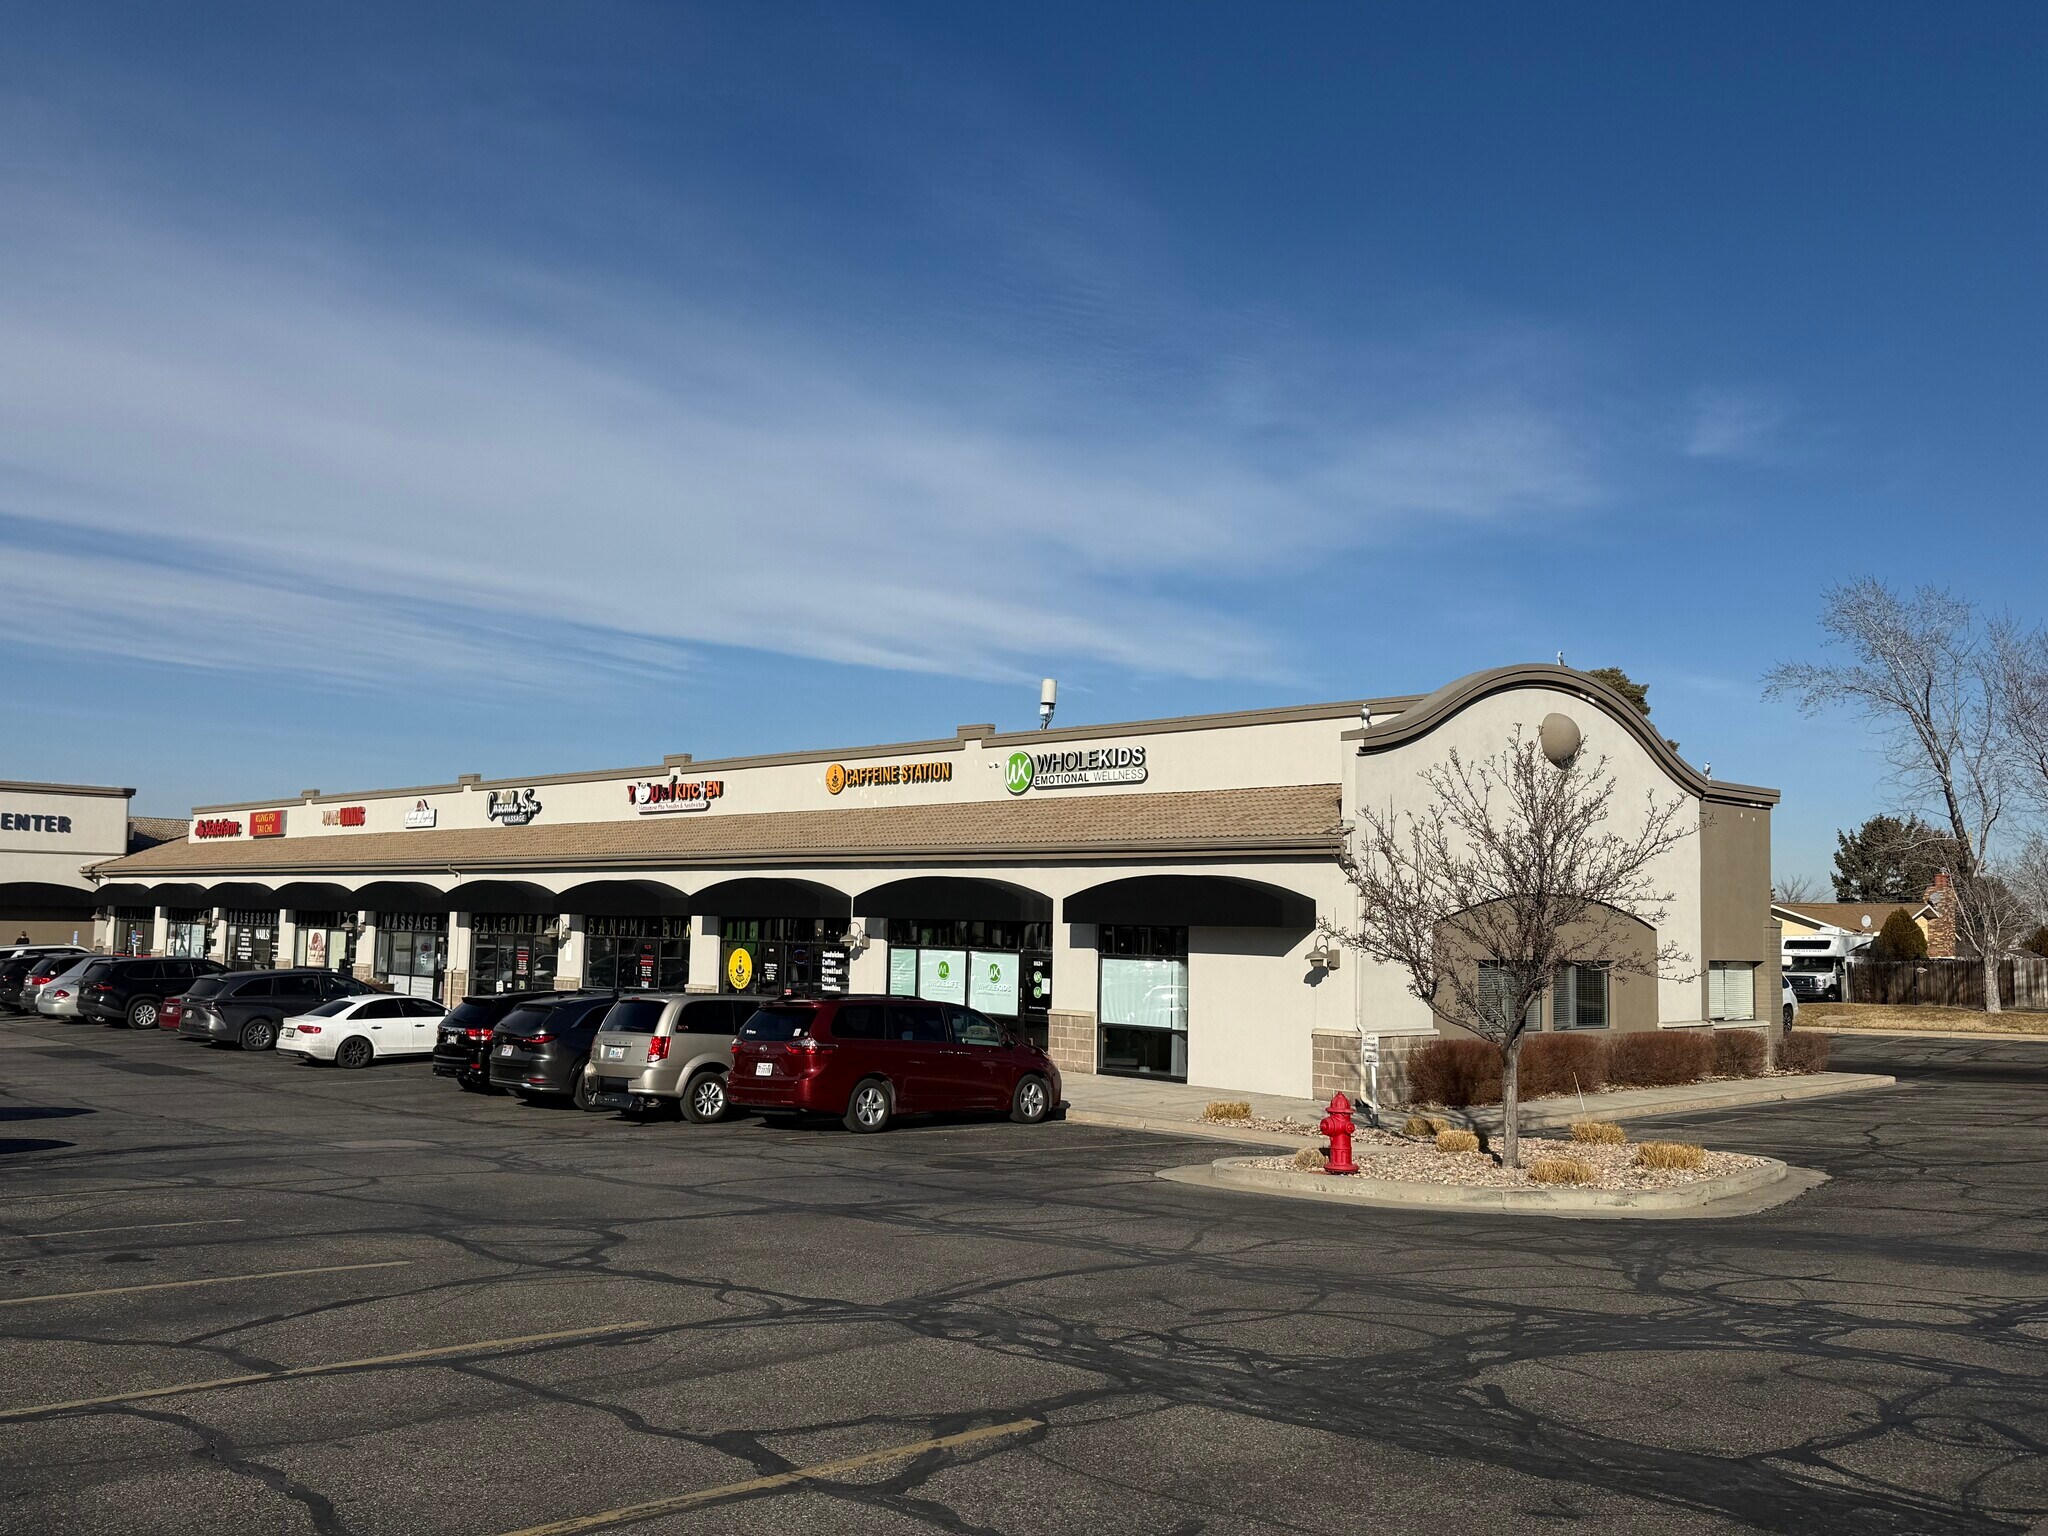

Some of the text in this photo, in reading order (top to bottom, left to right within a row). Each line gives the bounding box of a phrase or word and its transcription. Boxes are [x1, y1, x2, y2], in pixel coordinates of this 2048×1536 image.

[1035, 746, 1146, 773] WHOLEKIDS
[845, 765, 899, 787] CAFFEINE
[900, 762, 952, 783] STATION
[1034, 768, 1145, 786] EMOTIONAL WELLNESS
[487, 789, 541, 819] Cascade Spa
[0, 812, 72, 833] ENTER
[255, 813, 276, 823] KUNG FU
[503, 814, 526, 823] MASSAGE
[384, 915, 438, 930] MASSAGE
[255, 928, 270, 940] NAILS
